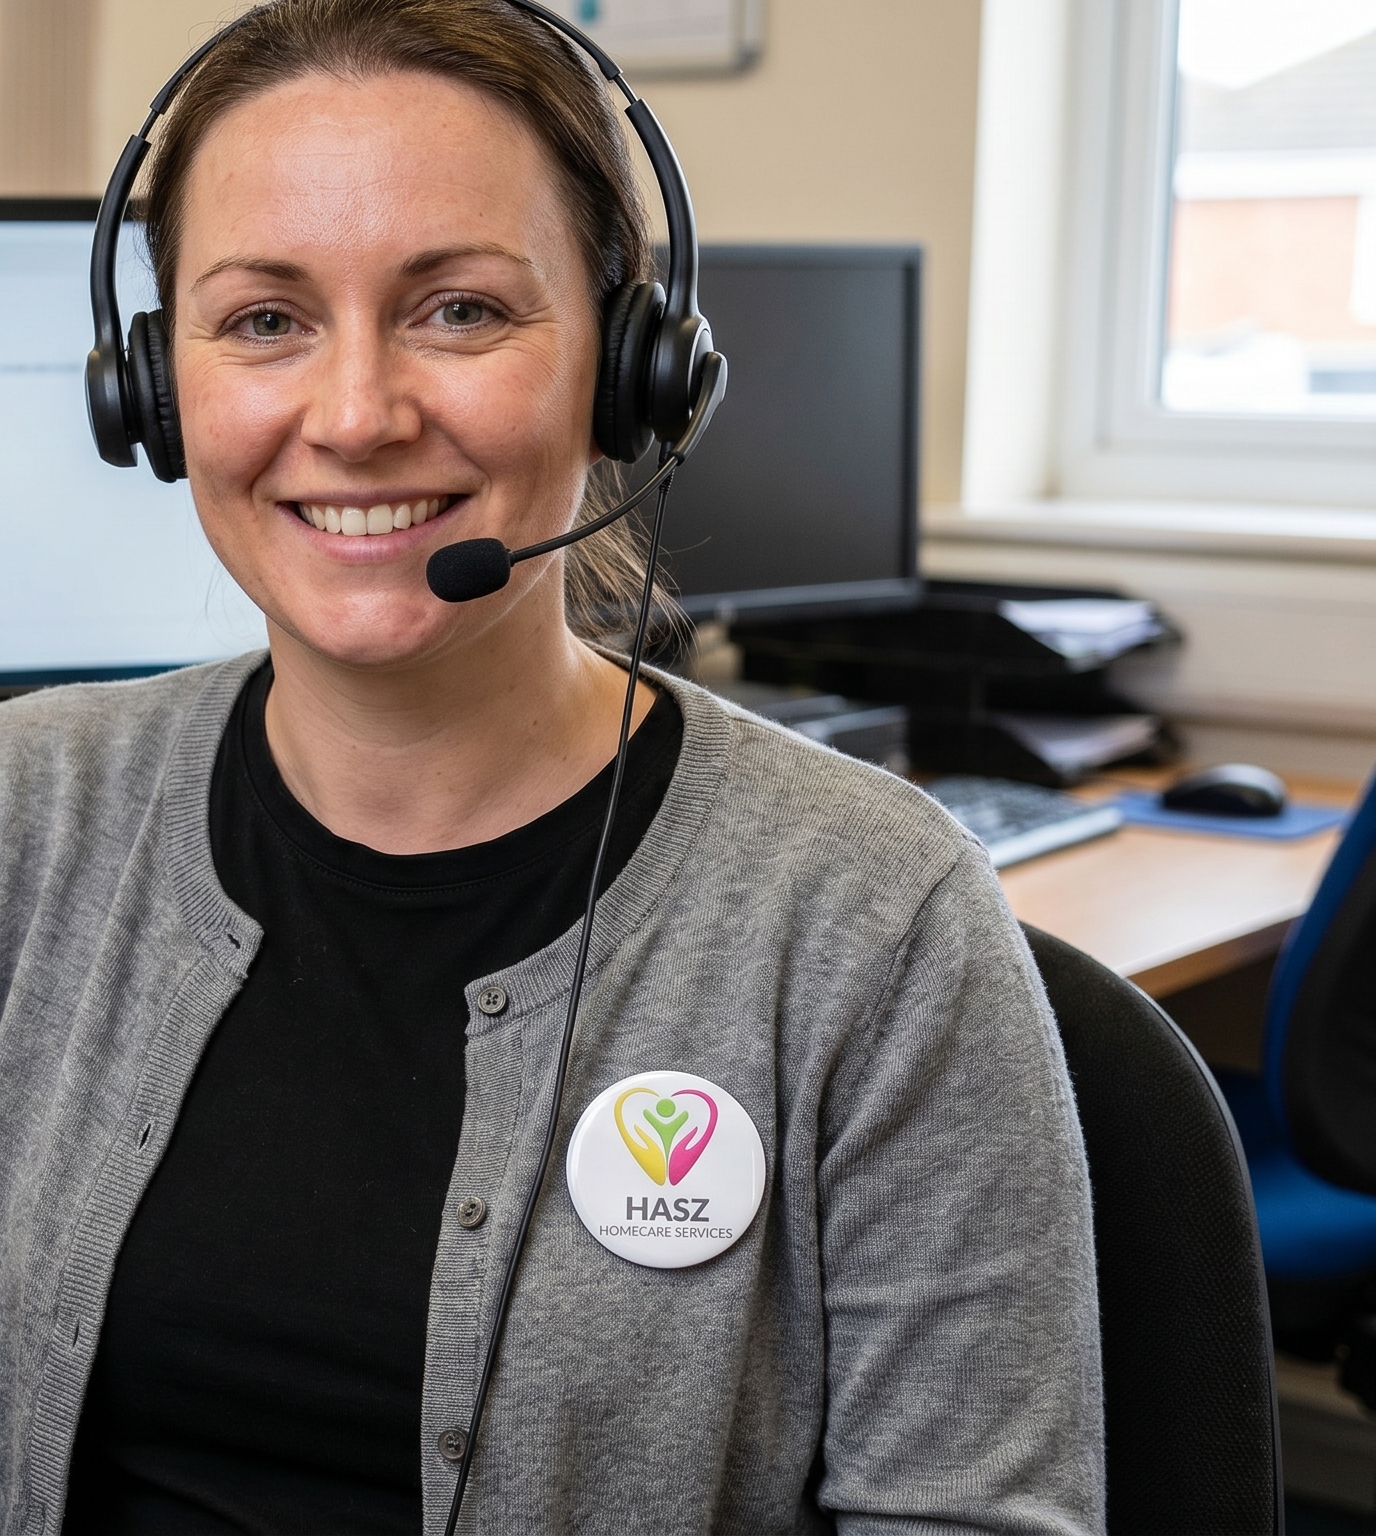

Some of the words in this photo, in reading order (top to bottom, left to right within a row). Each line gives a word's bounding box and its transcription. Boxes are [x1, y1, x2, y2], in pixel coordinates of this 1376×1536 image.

[626, 1196, 710, 1222] HASZ
[599, 1225, 672, 1238] HOMECARE
[674, 1227, 733, 1239] SERVICES
